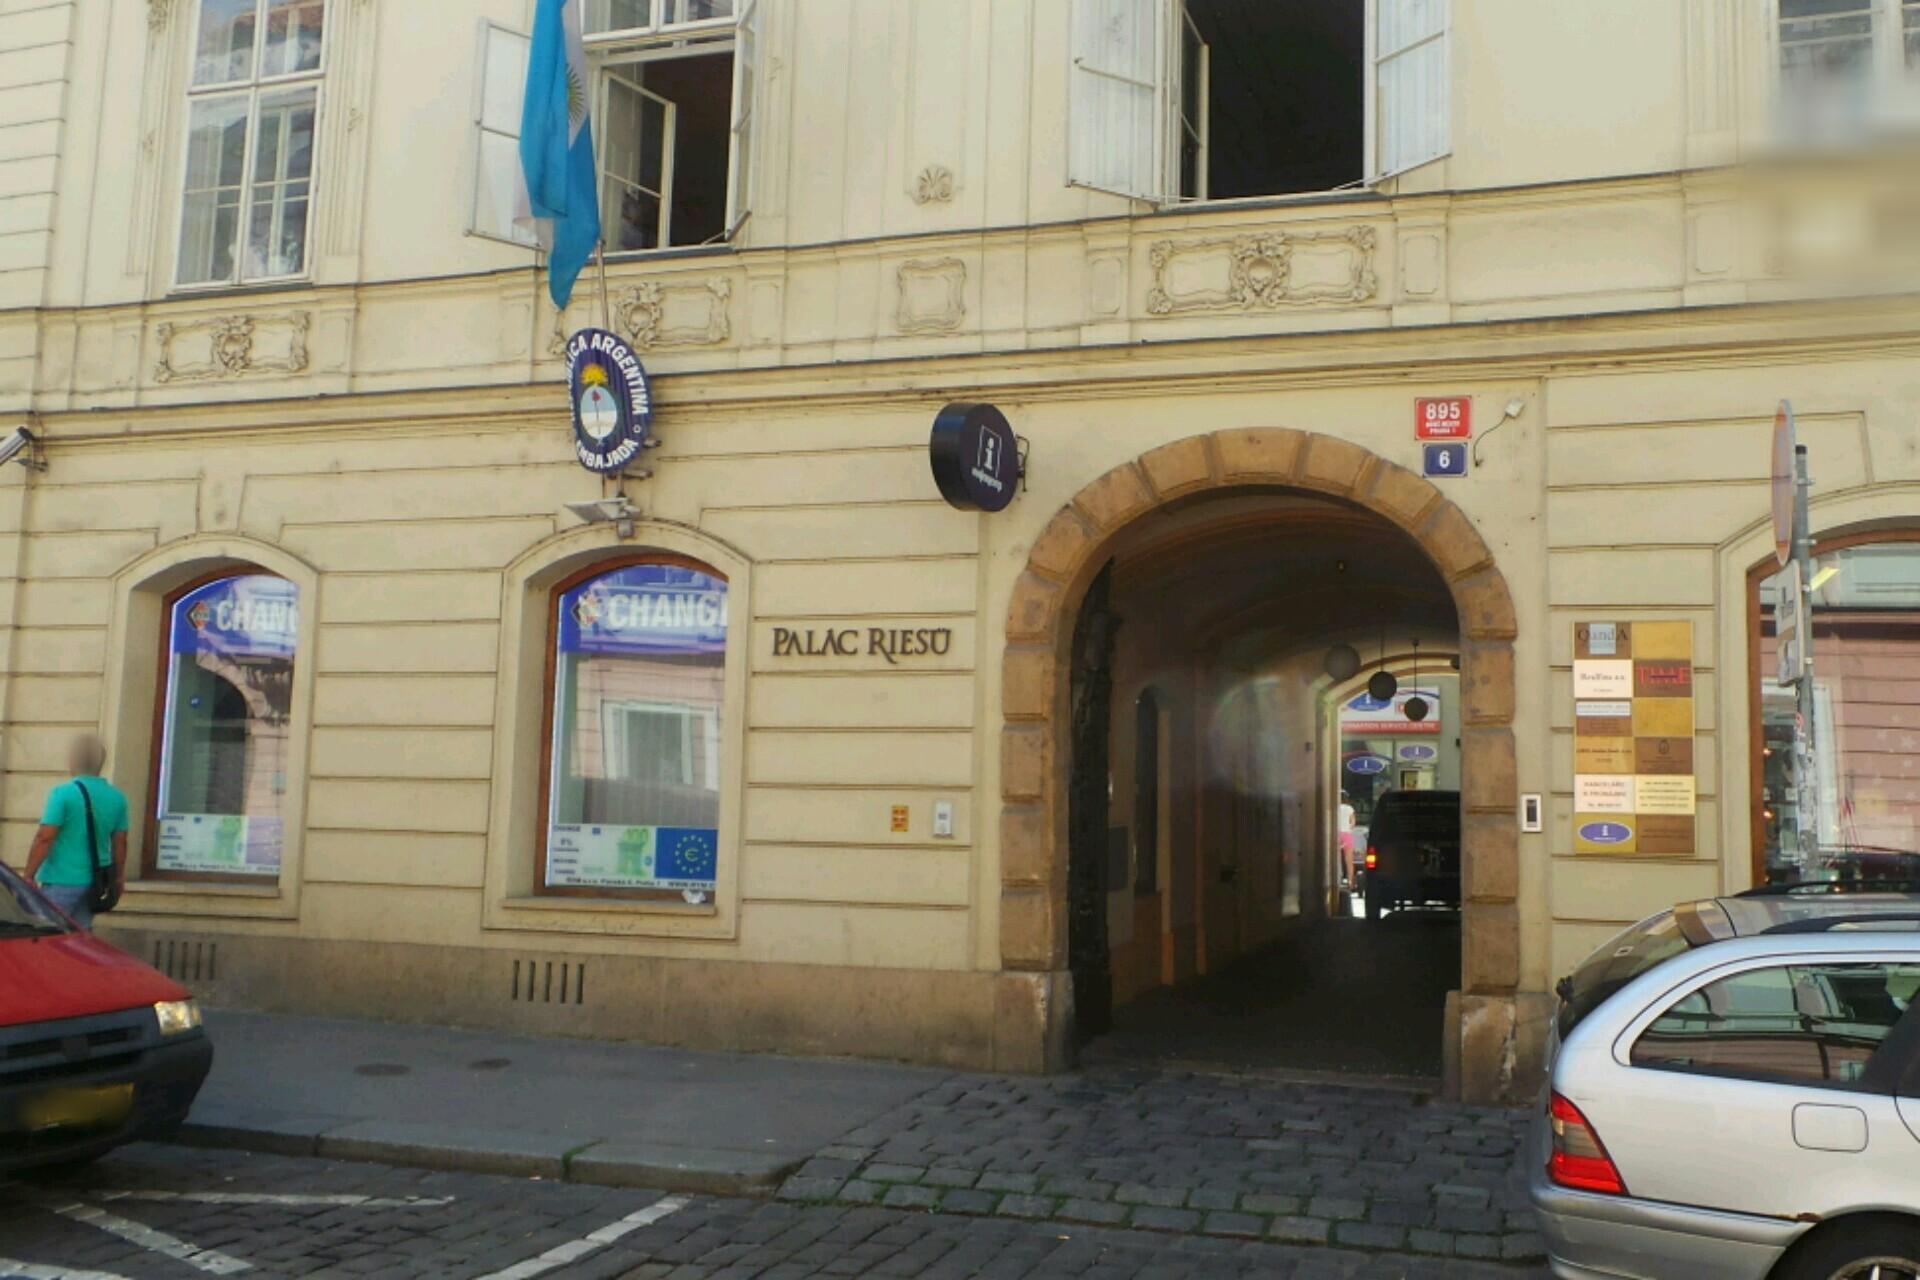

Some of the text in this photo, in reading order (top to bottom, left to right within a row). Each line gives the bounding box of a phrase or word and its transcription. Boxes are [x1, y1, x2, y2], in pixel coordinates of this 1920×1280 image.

[590, 332, 648, 415] ARGENTINA
[1425, 402, 1461, 420] 895
[1439, 449, 1450, 469] 6
